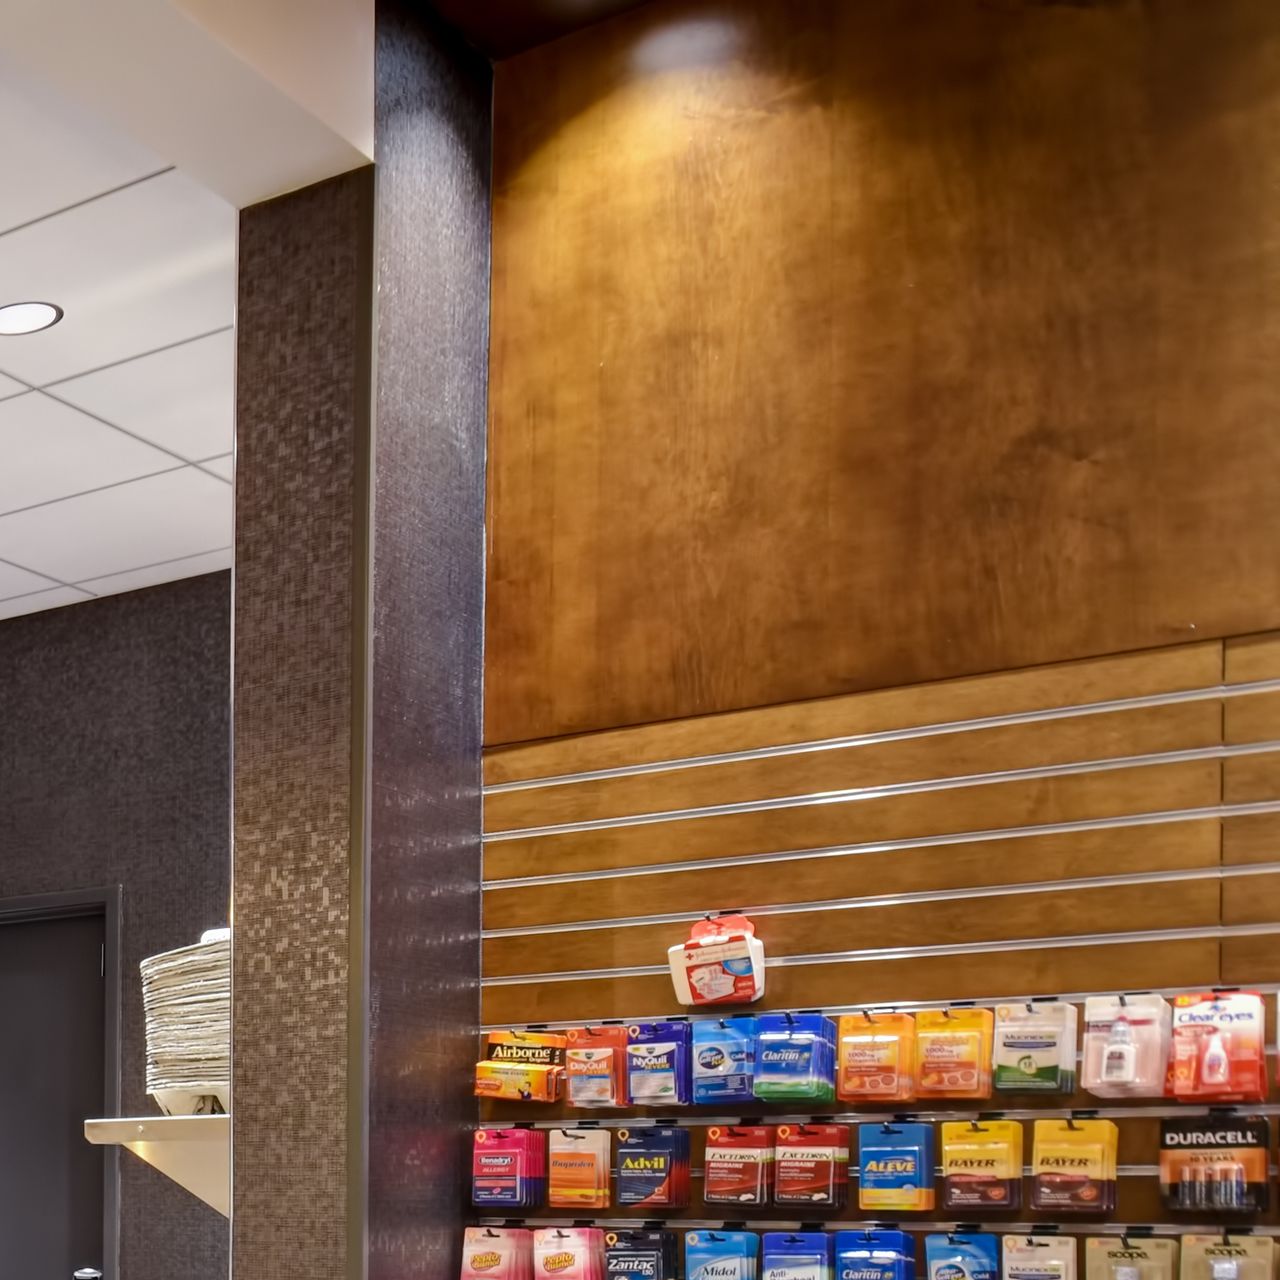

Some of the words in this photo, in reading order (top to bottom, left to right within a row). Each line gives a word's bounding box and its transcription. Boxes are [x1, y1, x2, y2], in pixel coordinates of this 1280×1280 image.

[1179, 1012, 1214, 1023] Clear
[1219, 1012, 1254, 1023] eyes
[492, 1046, 552, 1058] Airborne
[762, 1051, 799, 1061] Claritin
[570, 1062, 608, 1072] DayQuil
[632, 1055, 667, 1068] NyQuil
[1165, 1131, 1256, 1145] DURACELL
[481, 1156, 513, 1165] Benadryl
[621, 1157, 665, 1169] Advil
[865, 1160, 916, 1172] ALEVE
[948, 1158, 996, 1168] BAYER
[1040, 1156, 1090, 1167] BAYER
[1108, 1250, 1148, 1260] scope
[1205, 1247, 1246, 1258] scope
[608, 1258, 655, 1270] Zantac
[701, 1265, 737, 1277] Midol
[769, 1269, 789, 1278] Anti-
[842, 1269, 881, 1280] Claritin
